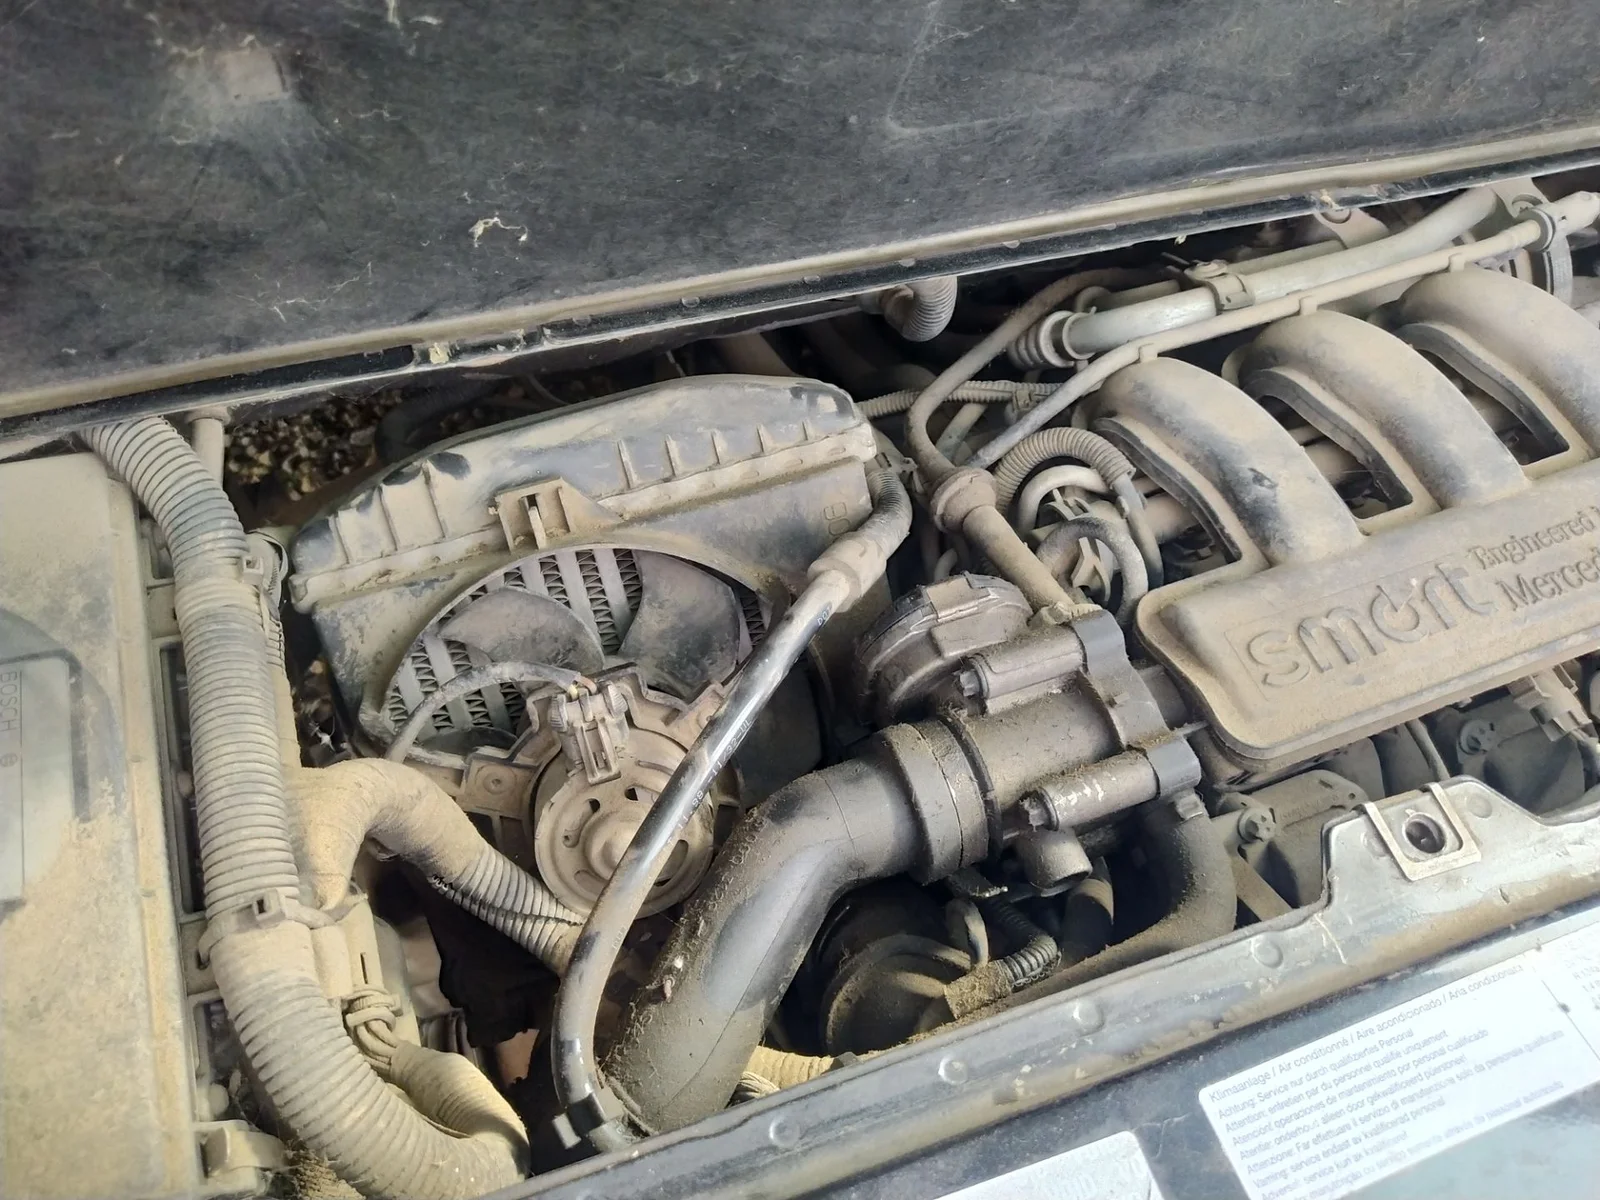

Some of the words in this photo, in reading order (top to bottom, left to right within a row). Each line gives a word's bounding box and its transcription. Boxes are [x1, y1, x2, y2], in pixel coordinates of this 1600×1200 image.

[1467, 509, 1596, 570] Engineered
[1247, 562, 1497, 689] smart
[0, 671, 18, 732] BOSCH
[1209, 1072, 1271, 1103] Klimaanlage
[1279, 1062, 1292, 1074] Air
[1293, 1037, 1349, 1067] conditionné
[1356, 1028, 1375, 1040] Aire
[1376, 999, 1442, 1032] acondicionado
[1448, 988, 1468, 1000] Aria
[1218, 1098, 1257, 1119] Achtung:
[1257, 1084, 1289, 1102] Service
[1290, 1077, 1304, 1088] nur
[1305, 1066, 1329, 1082] durch
[1329, 1044, 1380, 1072] qualifiziertes
[1378, 1028, 1414, 1049] Personal
[1305, 1086, 1319, 1100] par
[1320, 1081, 1333, 1091] du
[1332, 1063, 1372, 1087] personnel
[1403, 1030, 1448, 1055] uniquement
[1397, 1062, 1411, 1075] por
[1412, 1047, 1447, 1069] personal
[1346, 1099, 1365, 1113] door
